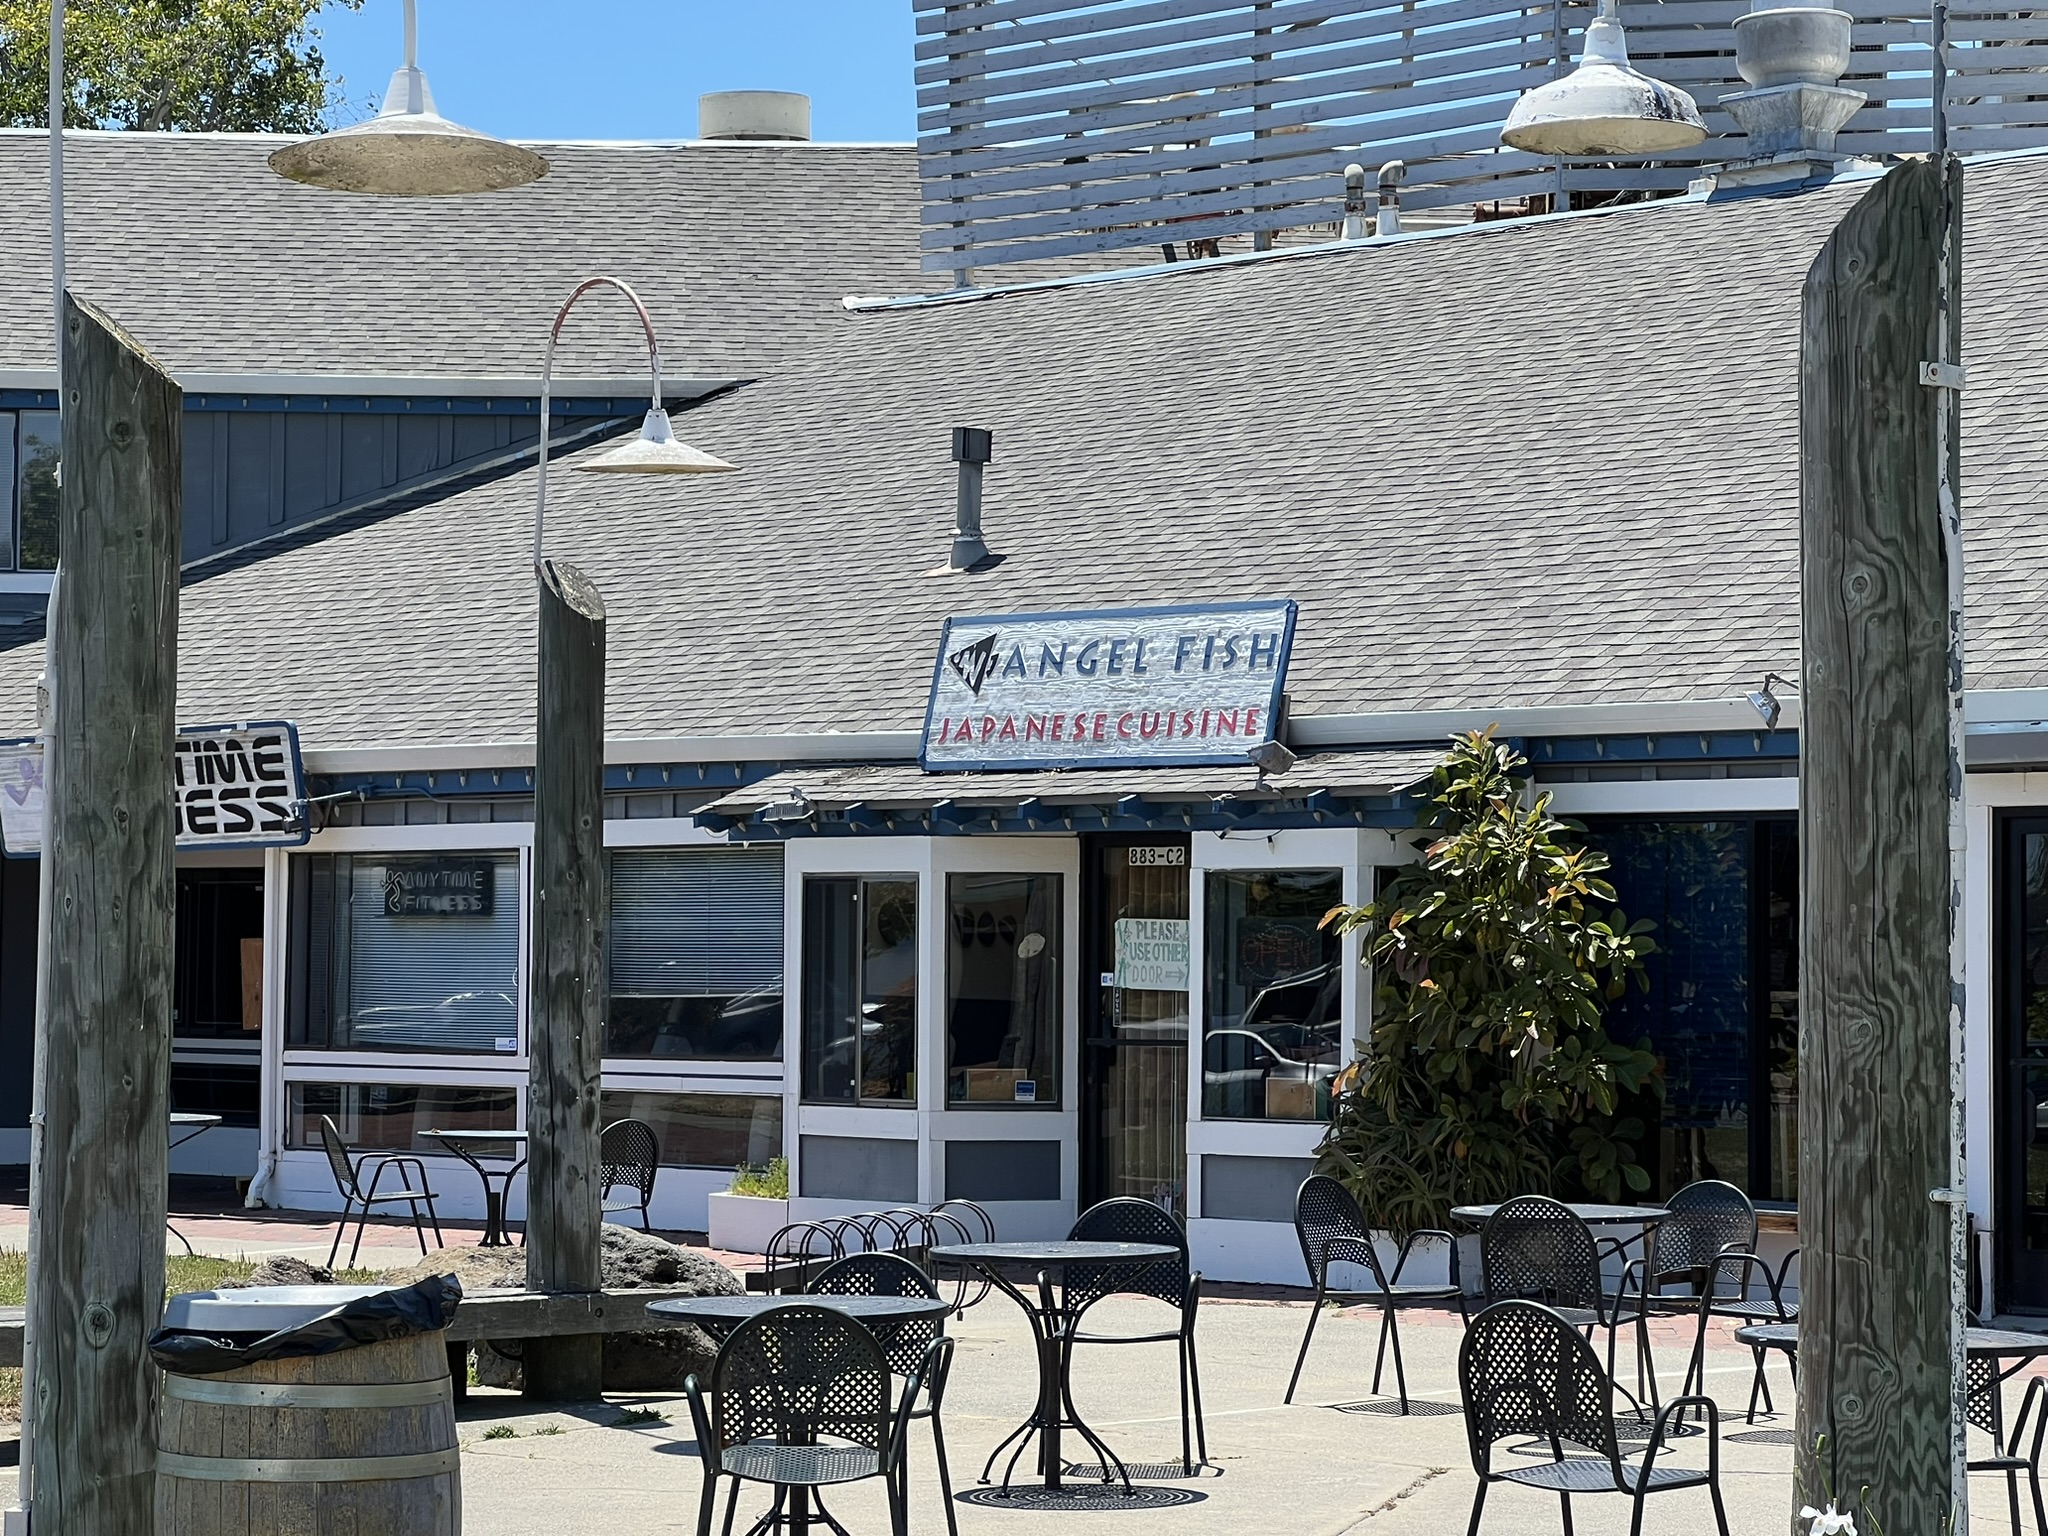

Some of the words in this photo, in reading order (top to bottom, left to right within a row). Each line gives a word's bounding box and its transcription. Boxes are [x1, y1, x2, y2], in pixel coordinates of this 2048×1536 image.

[1002, 636, 1147, 679] ANGEL
[1174, 633, 1280, 672] FISH
[938, 711, 1108, 745] JAPANESE
[1117, 708, 1260, 739] CUISINE
[1130, 848, 1183, 865] 883-C2
[404, 870, 484, 889] ANYTIME
[1135, 920, 1180, 941] PLEASE
[1129, 942, 1151, 962] USE
[1152, 942, 1188, 962] OTHER
[1242, 938, 1311, 967] OPEN
[1132, 965, 1163, 984] DOOR
